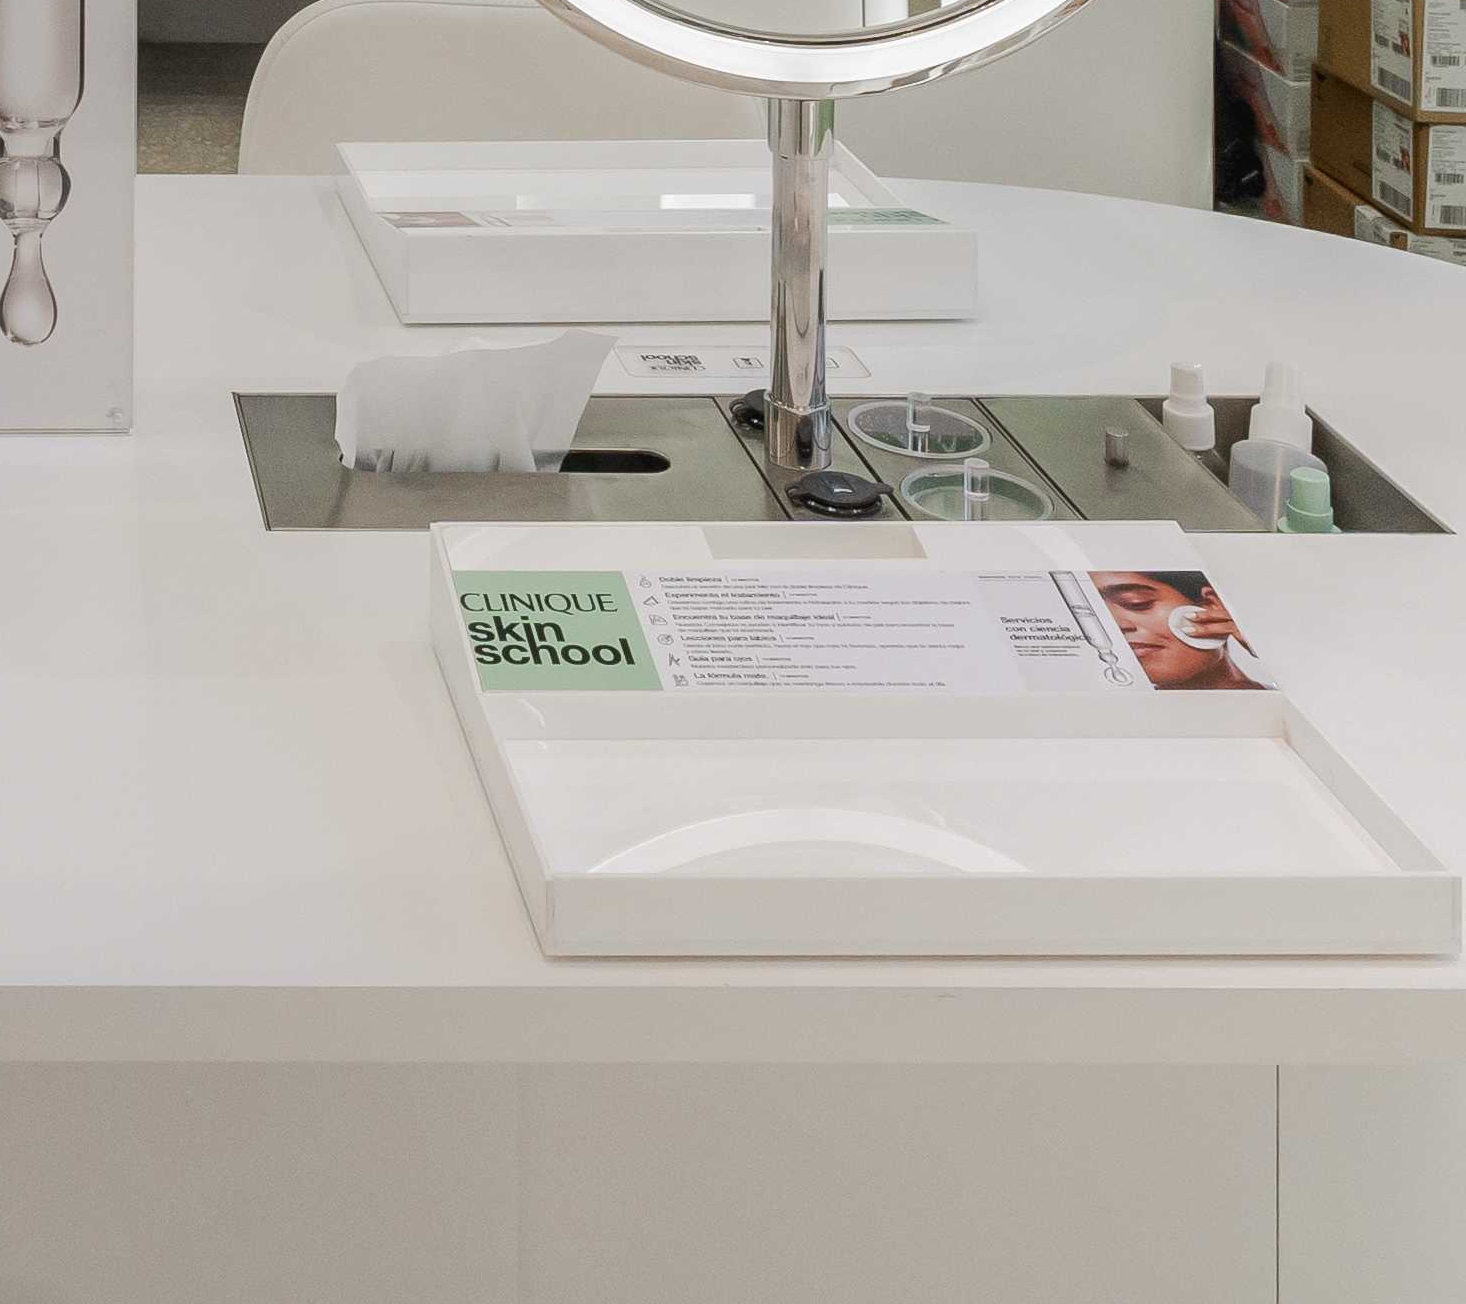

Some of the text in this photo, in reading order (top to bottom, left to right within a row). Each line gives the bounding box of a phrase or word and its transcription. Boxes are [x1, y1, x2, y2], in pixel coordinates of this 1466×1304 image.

[459, 591, 619, 616] CLINIQUE
[467, 614, 563, 644] skin
[474, 638, 636, 668] school
